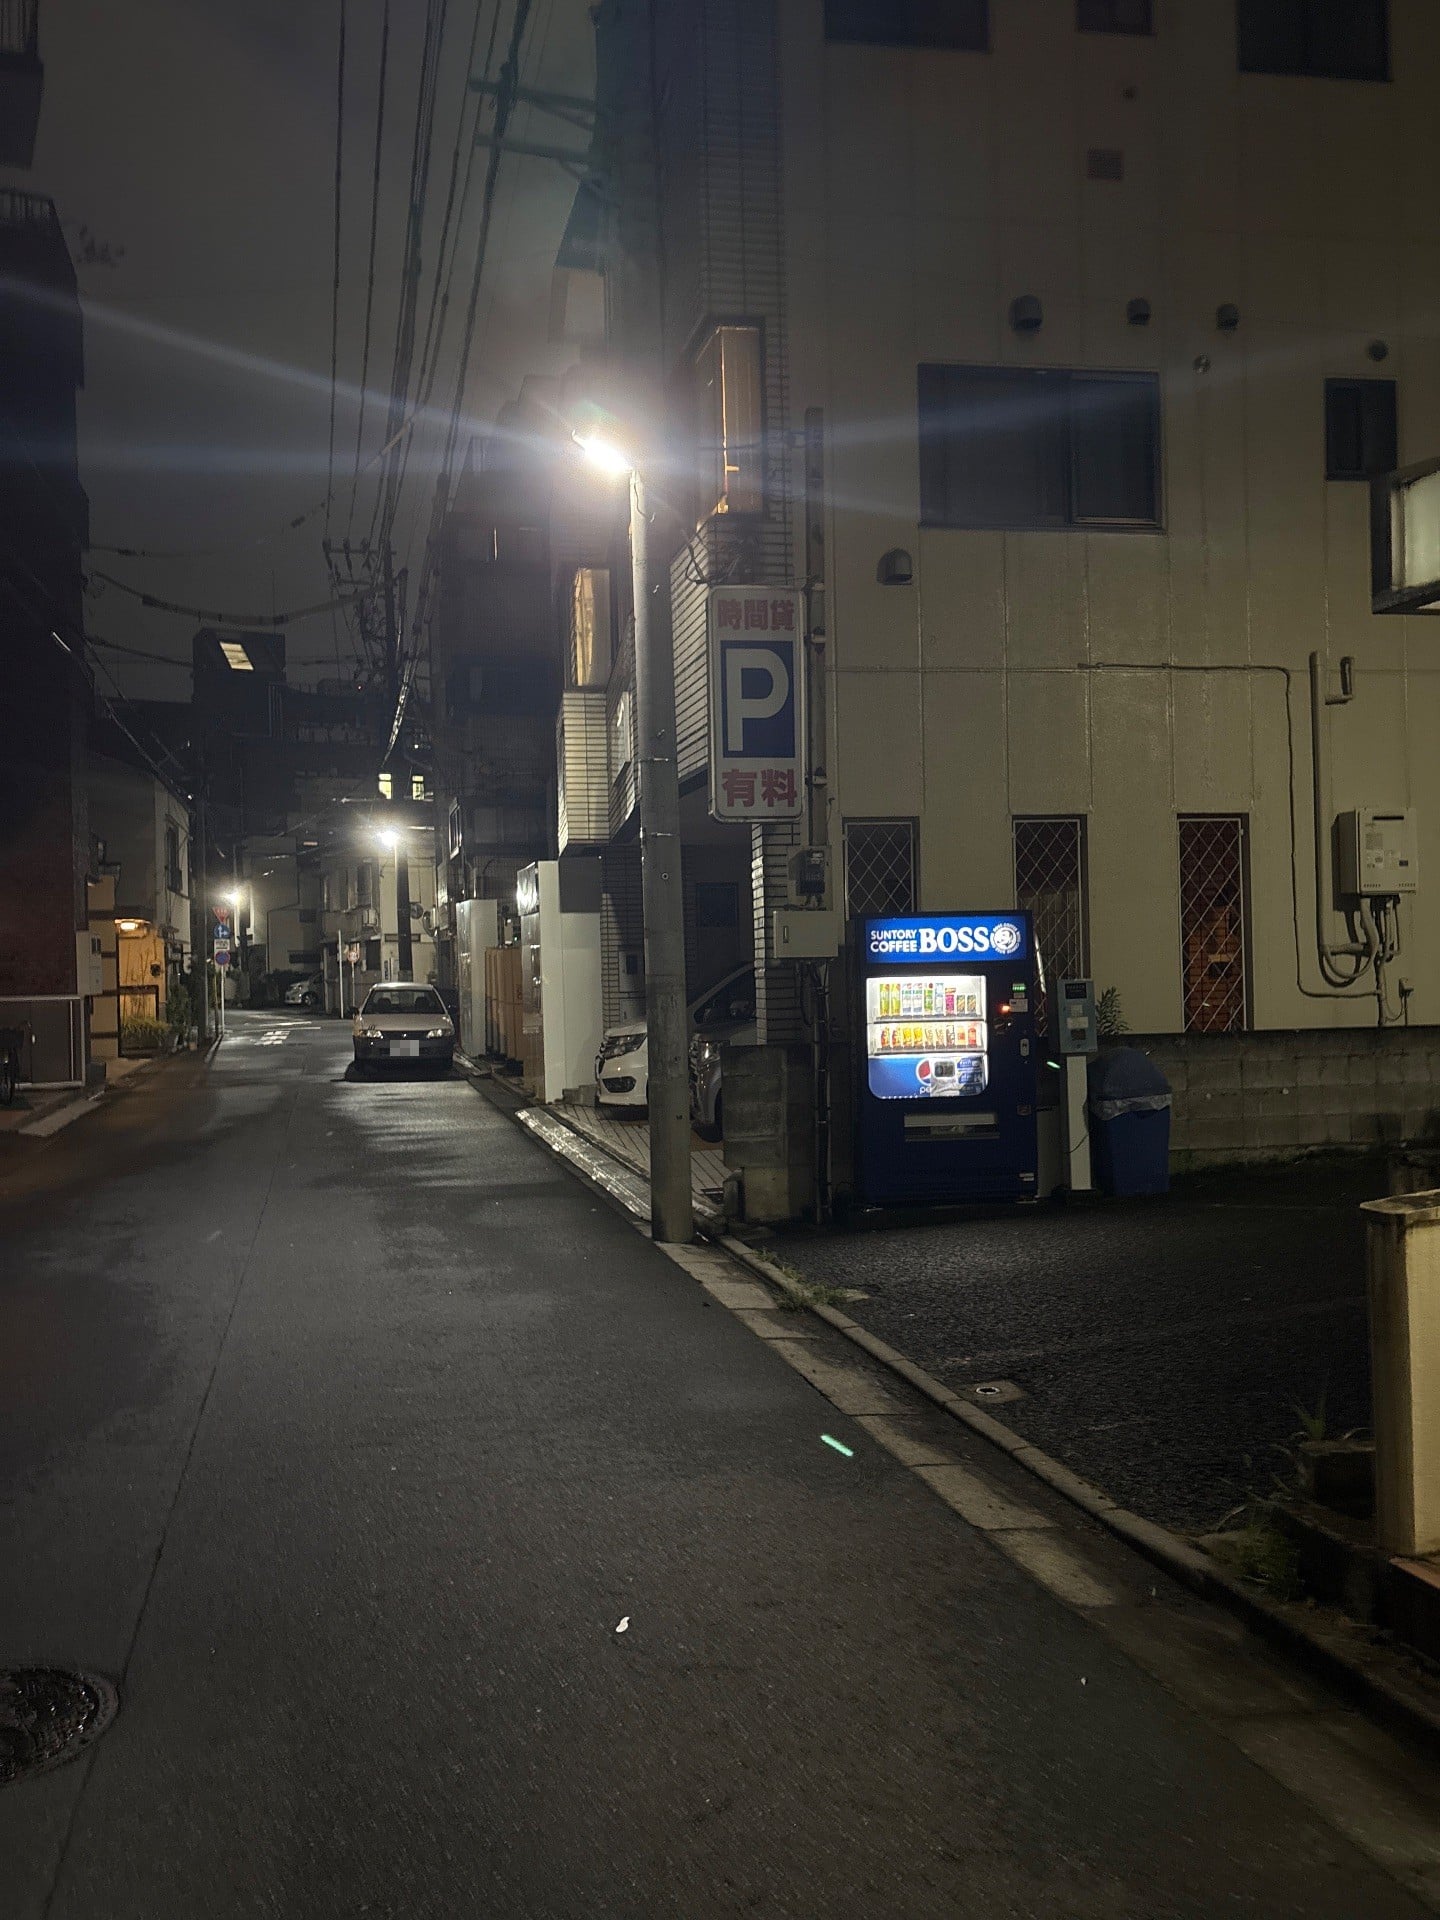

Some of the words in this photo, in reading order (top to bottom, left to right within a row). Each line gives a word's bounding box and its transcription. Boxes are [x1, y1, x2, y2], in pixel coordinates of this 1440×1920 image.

[718, 599, 795, 631] 時間貸
[726, 648, 789, 752] P
[722, 769, 797, 807] 有料
[871, 929, 917, 940] SUNTORY
[871, 941, 917, 952] COFFEE
[919, 927, 990, 953] BOSS
